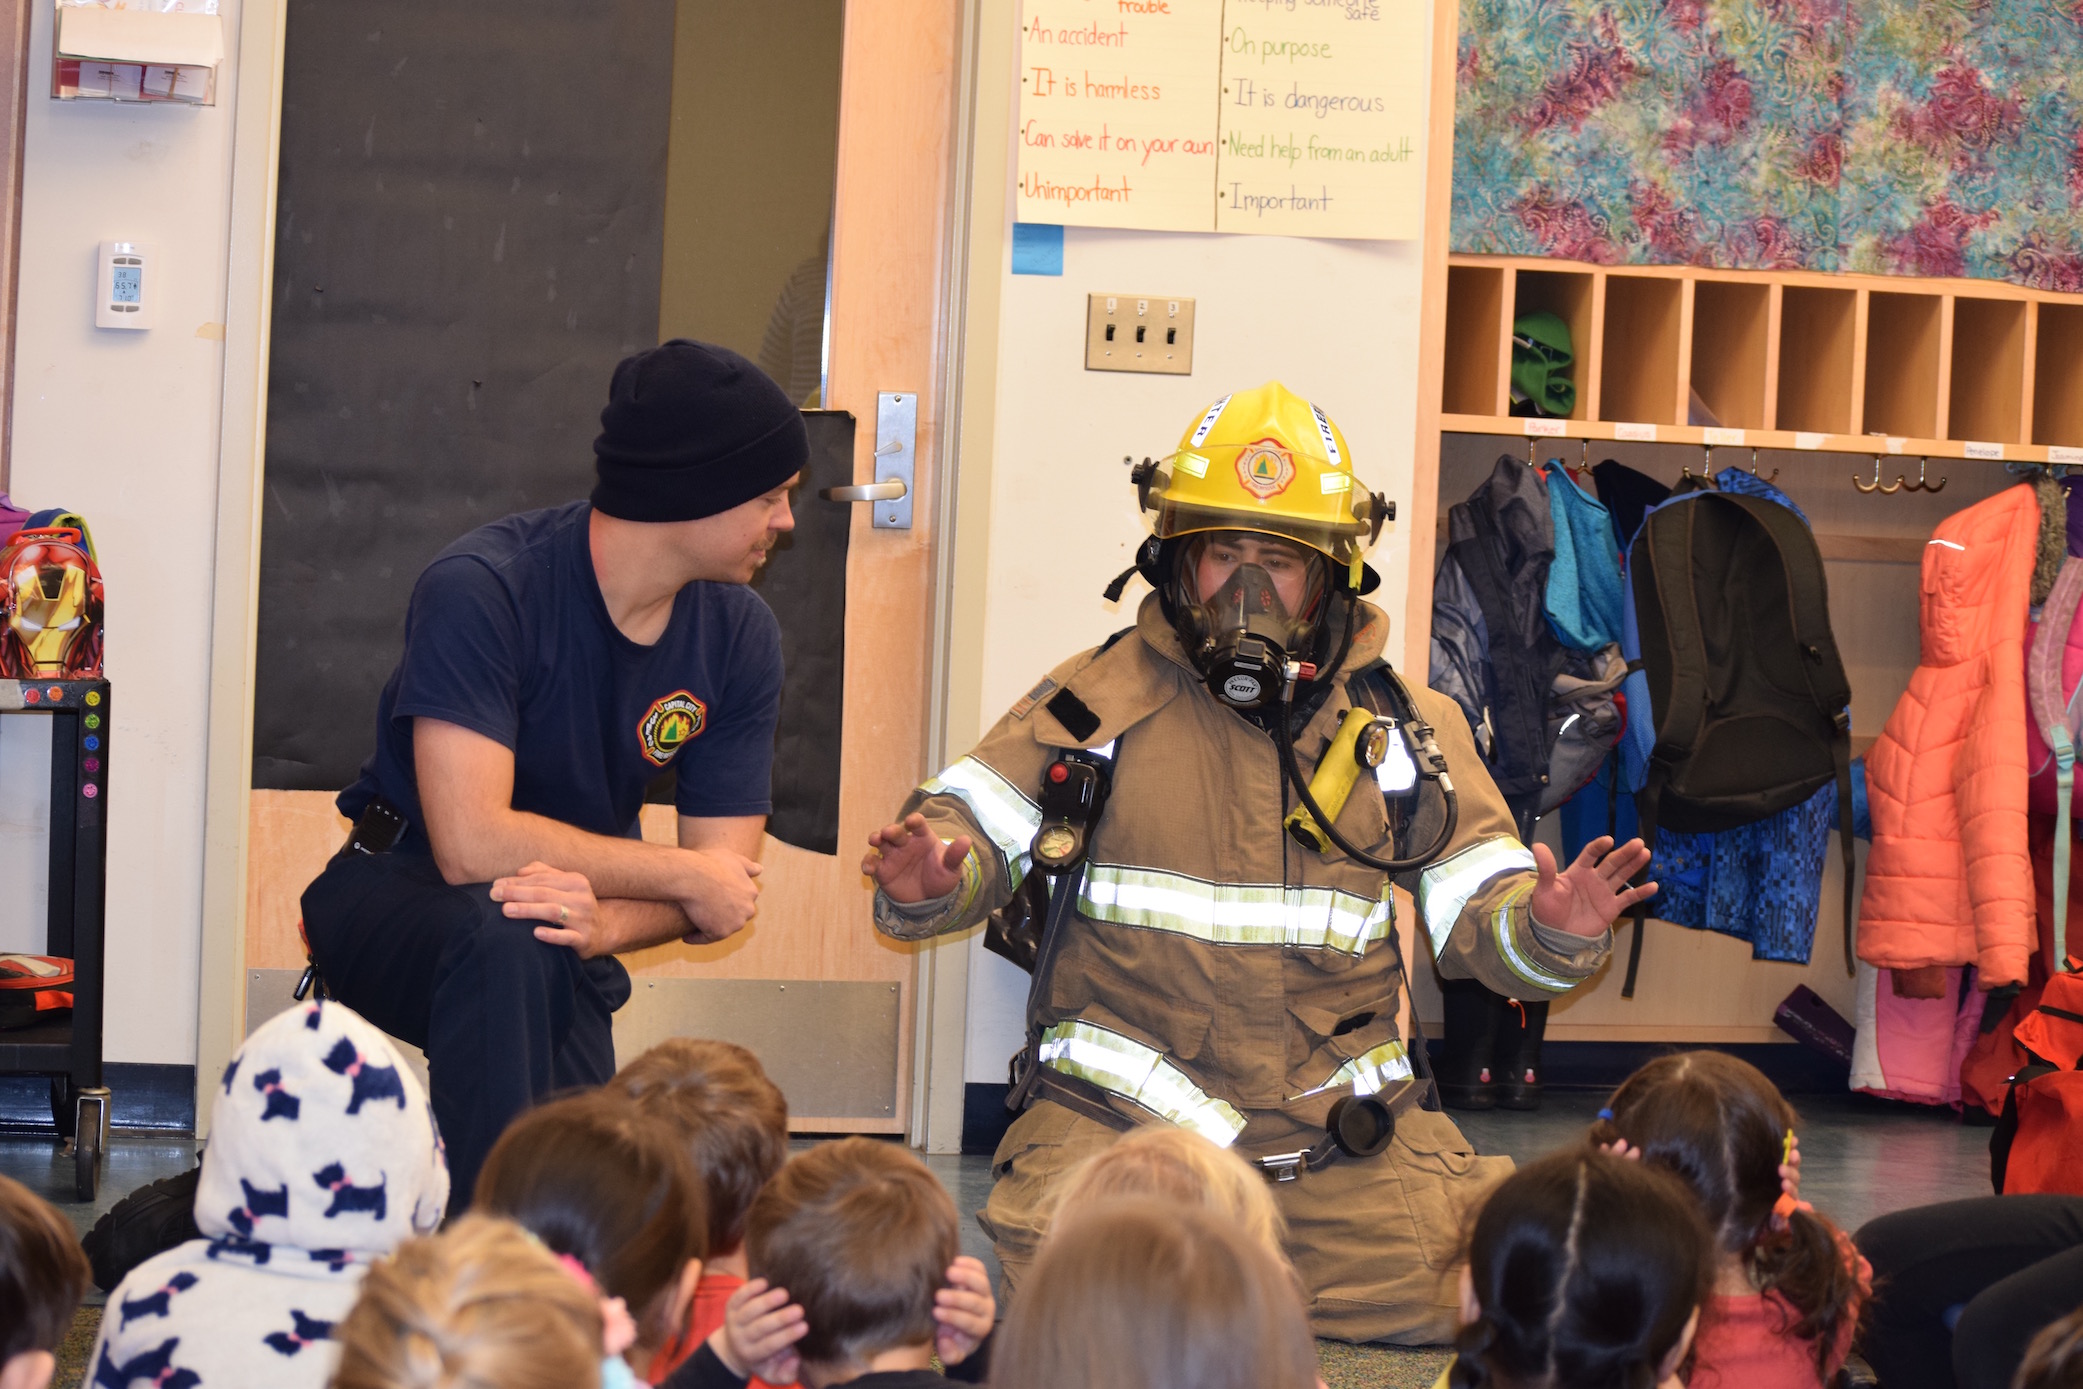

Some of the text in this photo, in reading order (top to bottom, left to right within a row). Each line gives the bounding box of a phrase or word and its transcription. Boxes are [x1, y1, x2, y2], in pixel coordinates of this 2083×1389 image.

[1117, 0, 1172, 15] trouble
[1345, 7, 1381, 21] safe
[1028, 15, 1129, 47] An accident
[1230, 26, 1333, 65] On purpose
[1030, 67, 1161, 100] It is harmless
[1232, 78, 1385, 119] It is dangerous
[1025, 118, 1055, 148] Can
[1061, 130, 1093, 150] solve
[1099, 122, 1112, 151] it
[1116, 136, 1137, 152] on
[1141, 138, 1179, 167] your
[1228, 130, 1414, 169] Need help from an adult
[1025, 171, 1133, 208] Unimportant
[1228, 182, 1334, 218] Important
[1966, 446, 2000, 457] Penelope
[1229, 684, 1256, 693] SCOTT
[685, 701, 698, 713] CITY
